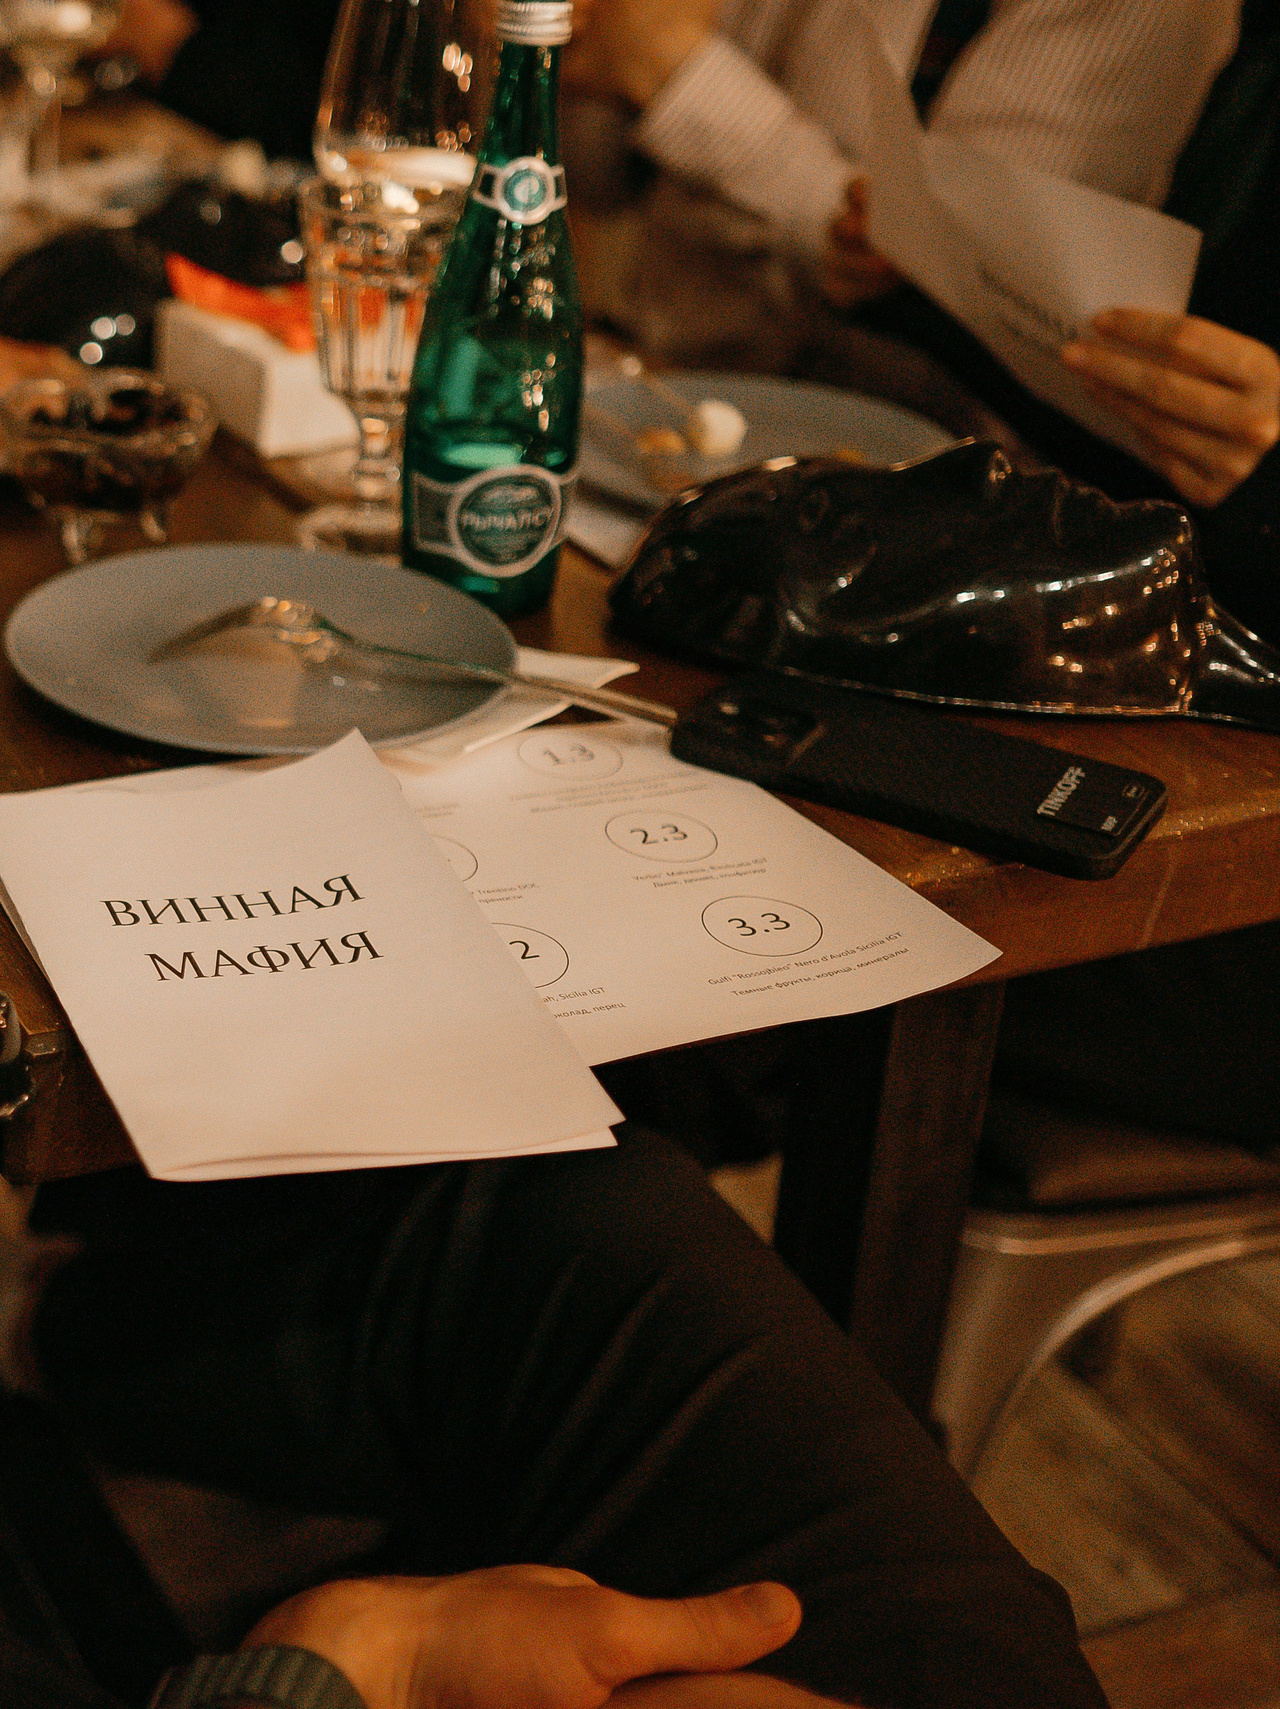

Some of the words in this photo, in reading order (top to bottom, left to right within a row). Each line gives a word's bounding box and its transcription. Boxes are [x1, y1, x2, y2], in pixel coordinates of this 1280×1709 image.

[543, 743, 595, 766] 1.3
[1037, 766, 1086, 816] TINKOFF
[629, 823, 688, 845] 2.3
[100, 874, 365, 927] ВИННАЯ
[727, 912, 791, 937] 3.3
[144, 931, 385, 981] МАФИЯ
[708, 976, 731, 986] Gulfi
[794, 958, 820, 969] Nero
[821, 948, 856, 962] d'Avola
[856, 939, 885, 952] Sicilia
[885, 931, 903, 942] IGT
[731, 985, 773, 997] Темные
[775, 976, 816, 989] фрукты,
[816, 966, 857, 979] корица,
[857, 948, 909, 969] минералы
[543, 995, 559, 1004] ah,
[559, 989, 588, 1001] Sicilia
[588, 986, 606, 996] IGT
[554, 1007, 592, 1019] колад,
[593, 1002, 626, 1013] перец
